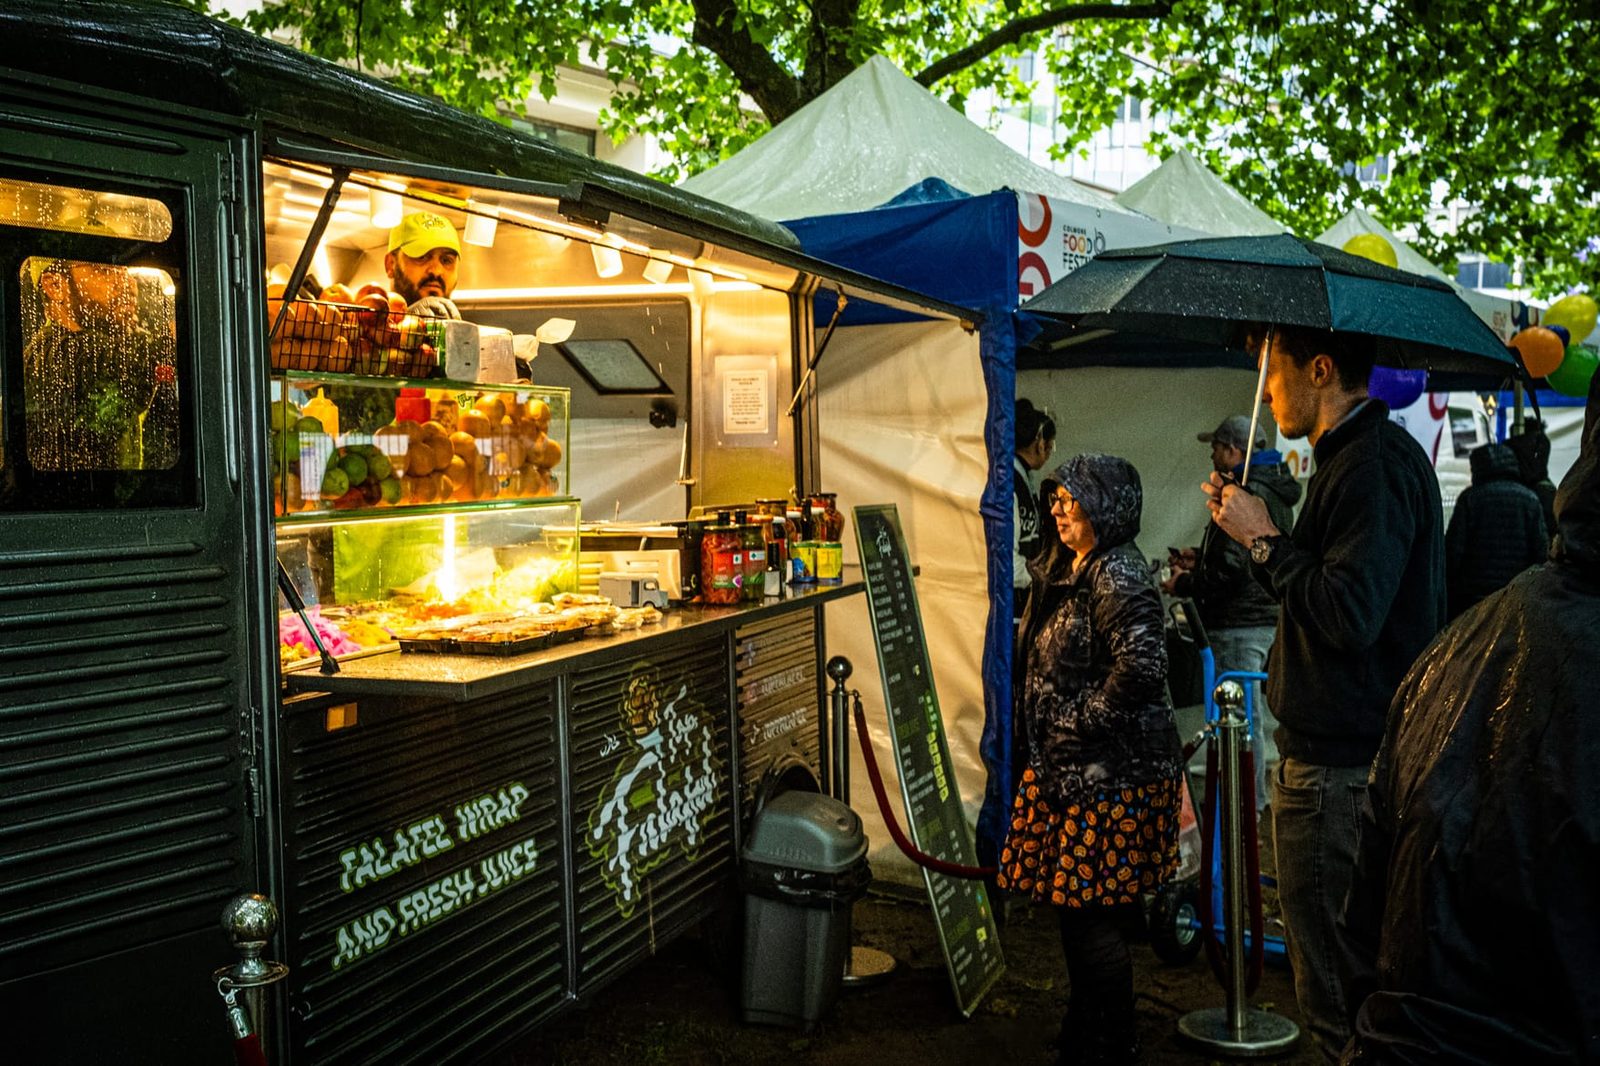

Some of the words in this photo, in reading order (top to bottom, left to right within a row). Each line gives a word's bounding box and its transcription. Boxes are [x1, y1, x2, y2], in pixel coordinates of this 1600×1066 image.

[1063, 233, 1093, 254] FOOD
[341, 815, 452, 891] FALAFEL
[455, 784, 529, 840] WRAP
[334, 908, 397, 967] AND
[399, 867, 475, 935] FRESH
[478, 838, 537, 894] JUICE
